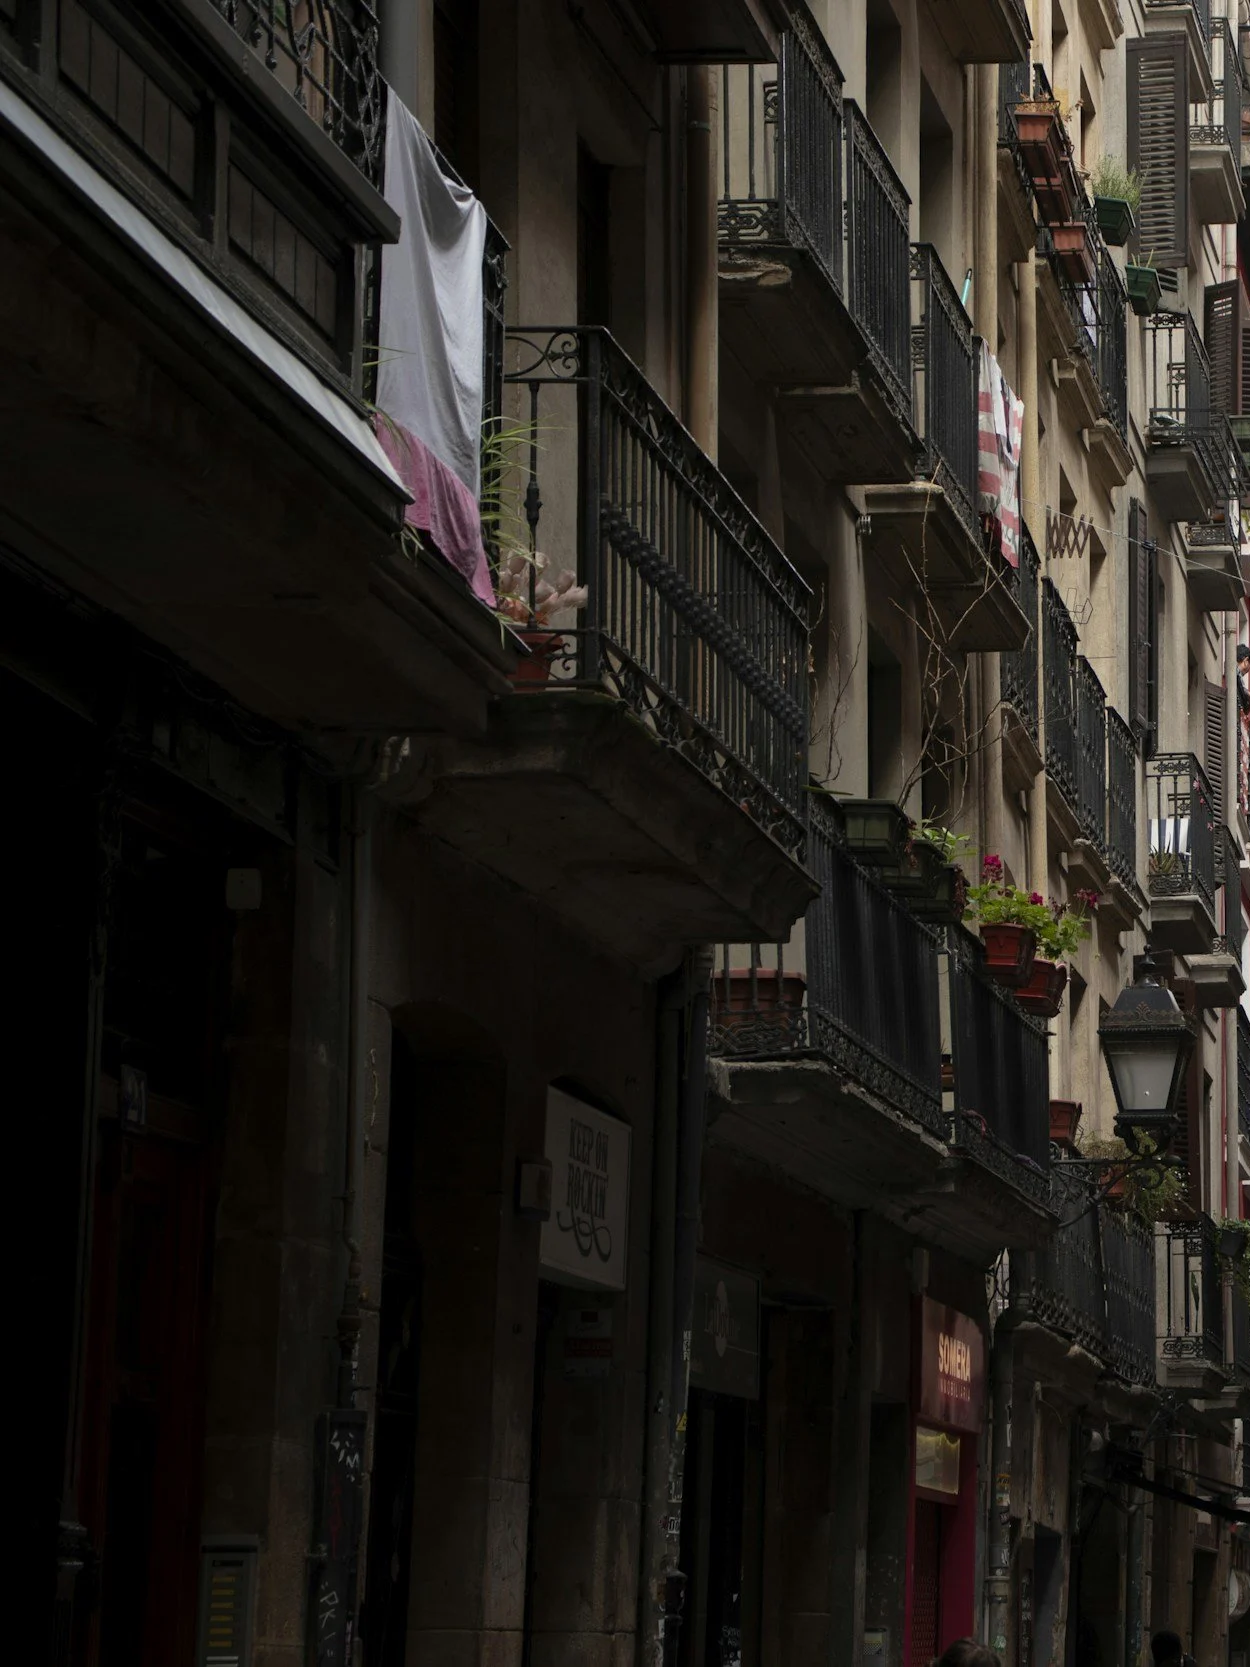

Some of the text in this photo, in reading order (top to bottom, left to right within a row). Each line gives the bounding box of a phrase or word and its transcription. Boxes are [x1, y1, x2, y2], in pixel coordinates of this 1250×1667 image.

[569, 1117, 609, 1173] KEEP ON
[938, 1332, 971, 1382] SOMERA
